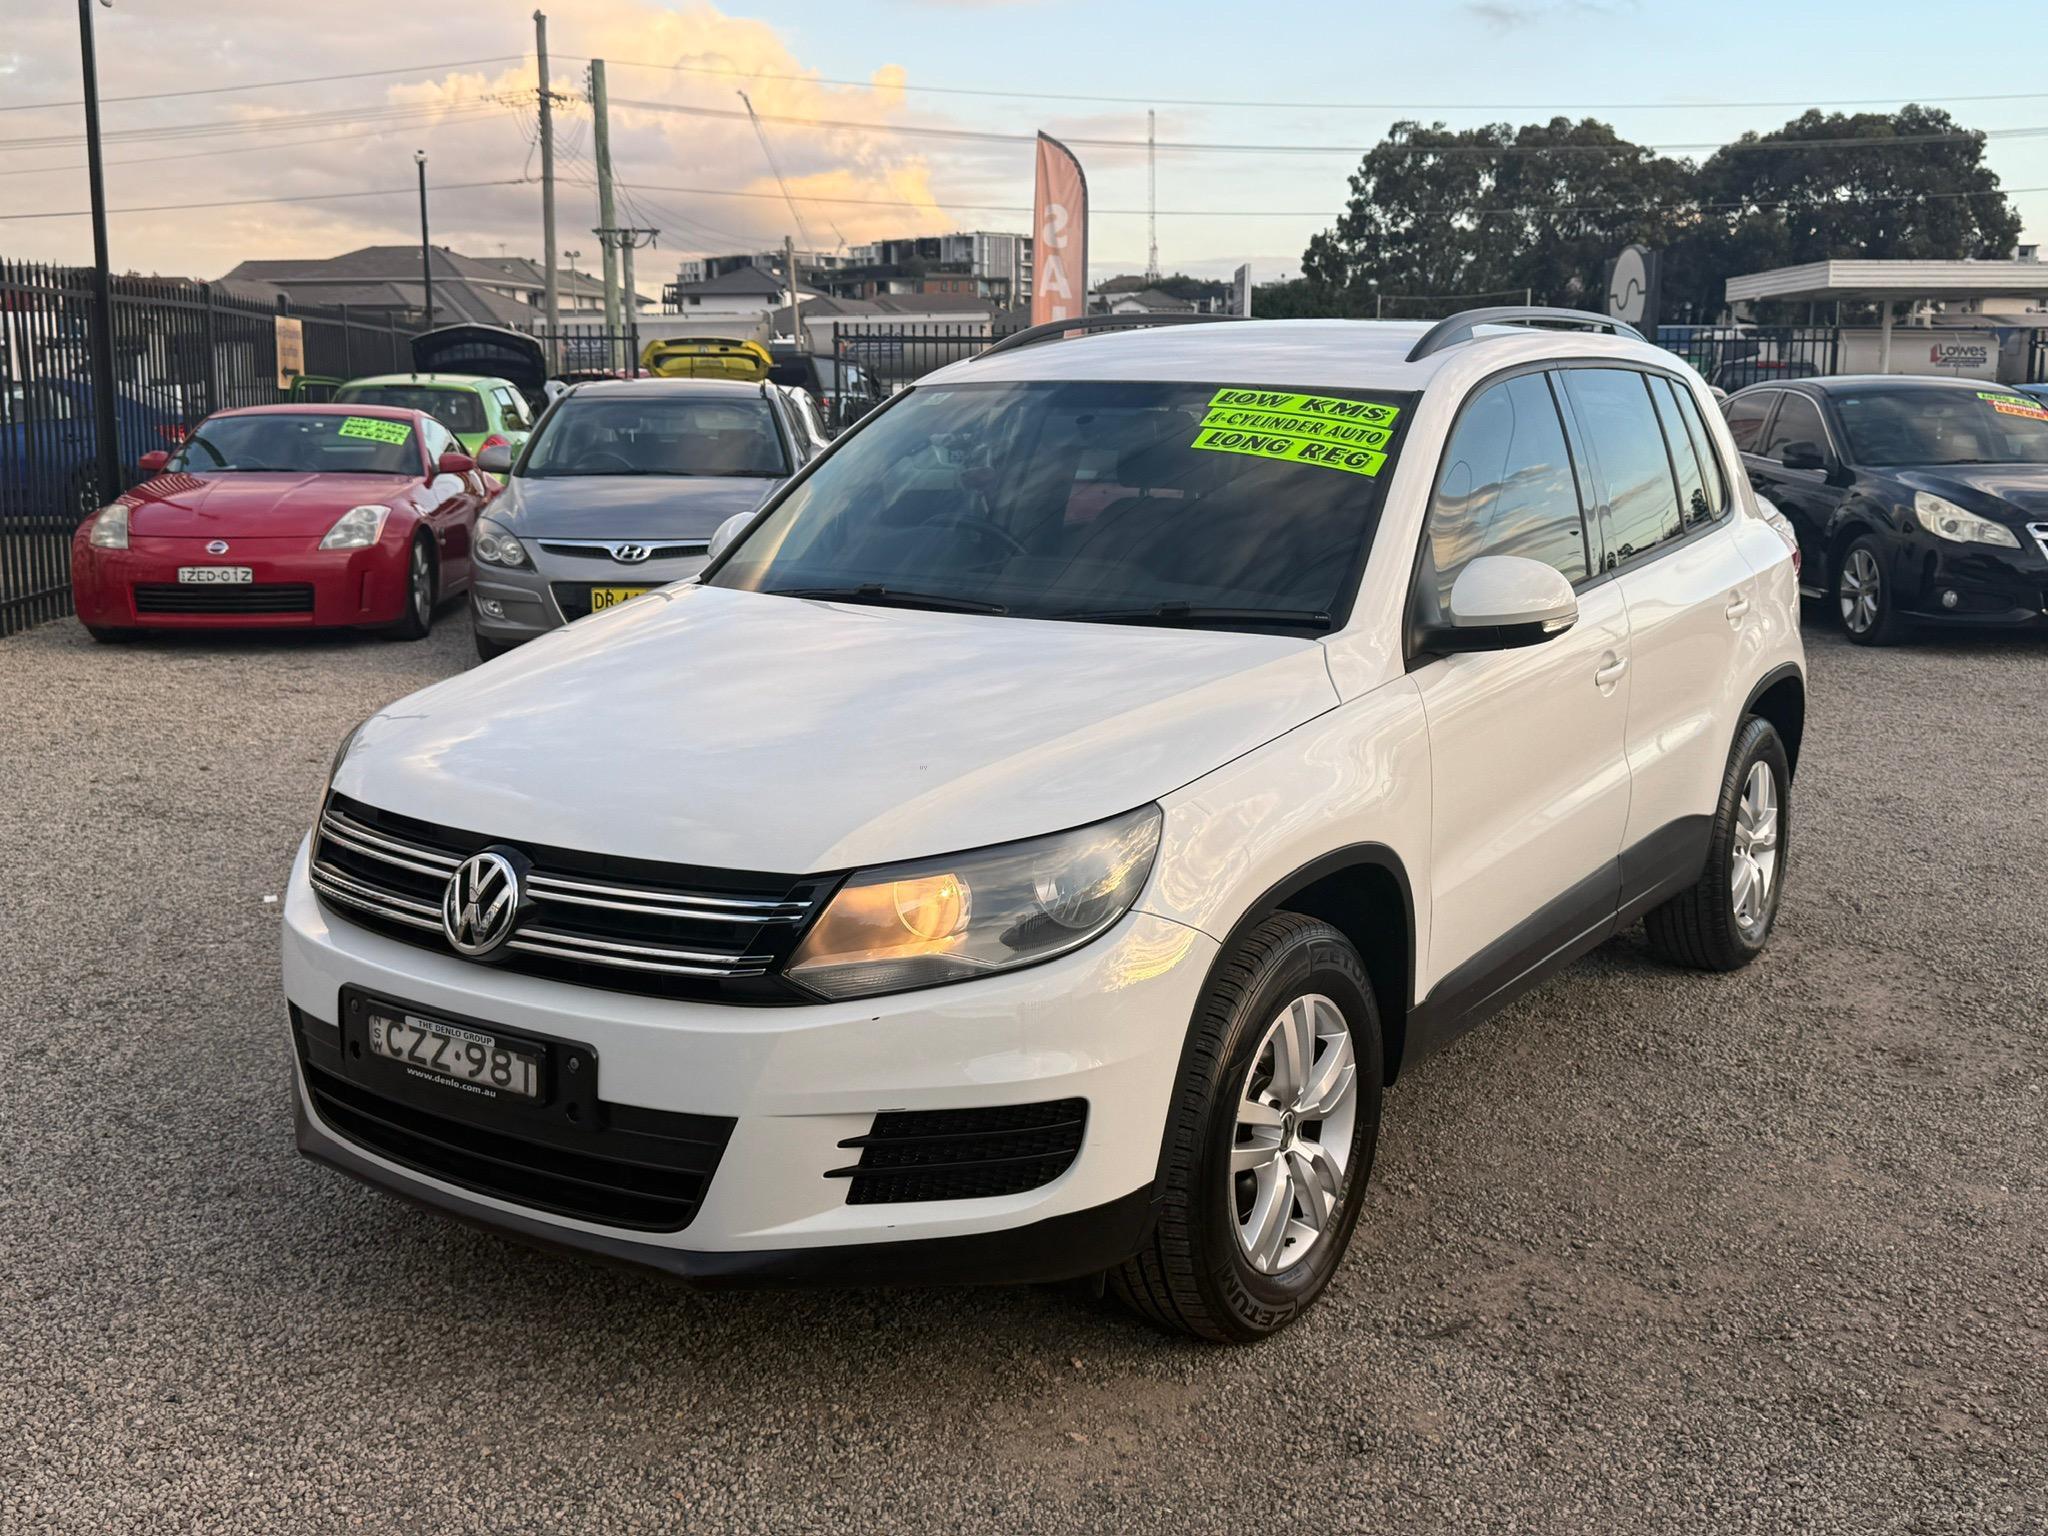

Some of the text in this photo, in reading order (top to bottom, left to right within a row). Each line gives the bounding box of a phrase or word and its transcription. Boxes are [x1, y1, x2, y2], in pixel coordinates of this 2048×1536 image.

[1938, 343, 1987, 356] Lowes
[1215, 390, 1391, 422] LOW KMS
[1206, 411, 1386, 445] 4-CYLINDER AUTO
[1203, 430, 1374, 469] LONG REG
[417, 1020, 493, 1046] THE DENLO GROUP
[406, 1067, 497, 1098] www.denlo.com.au
